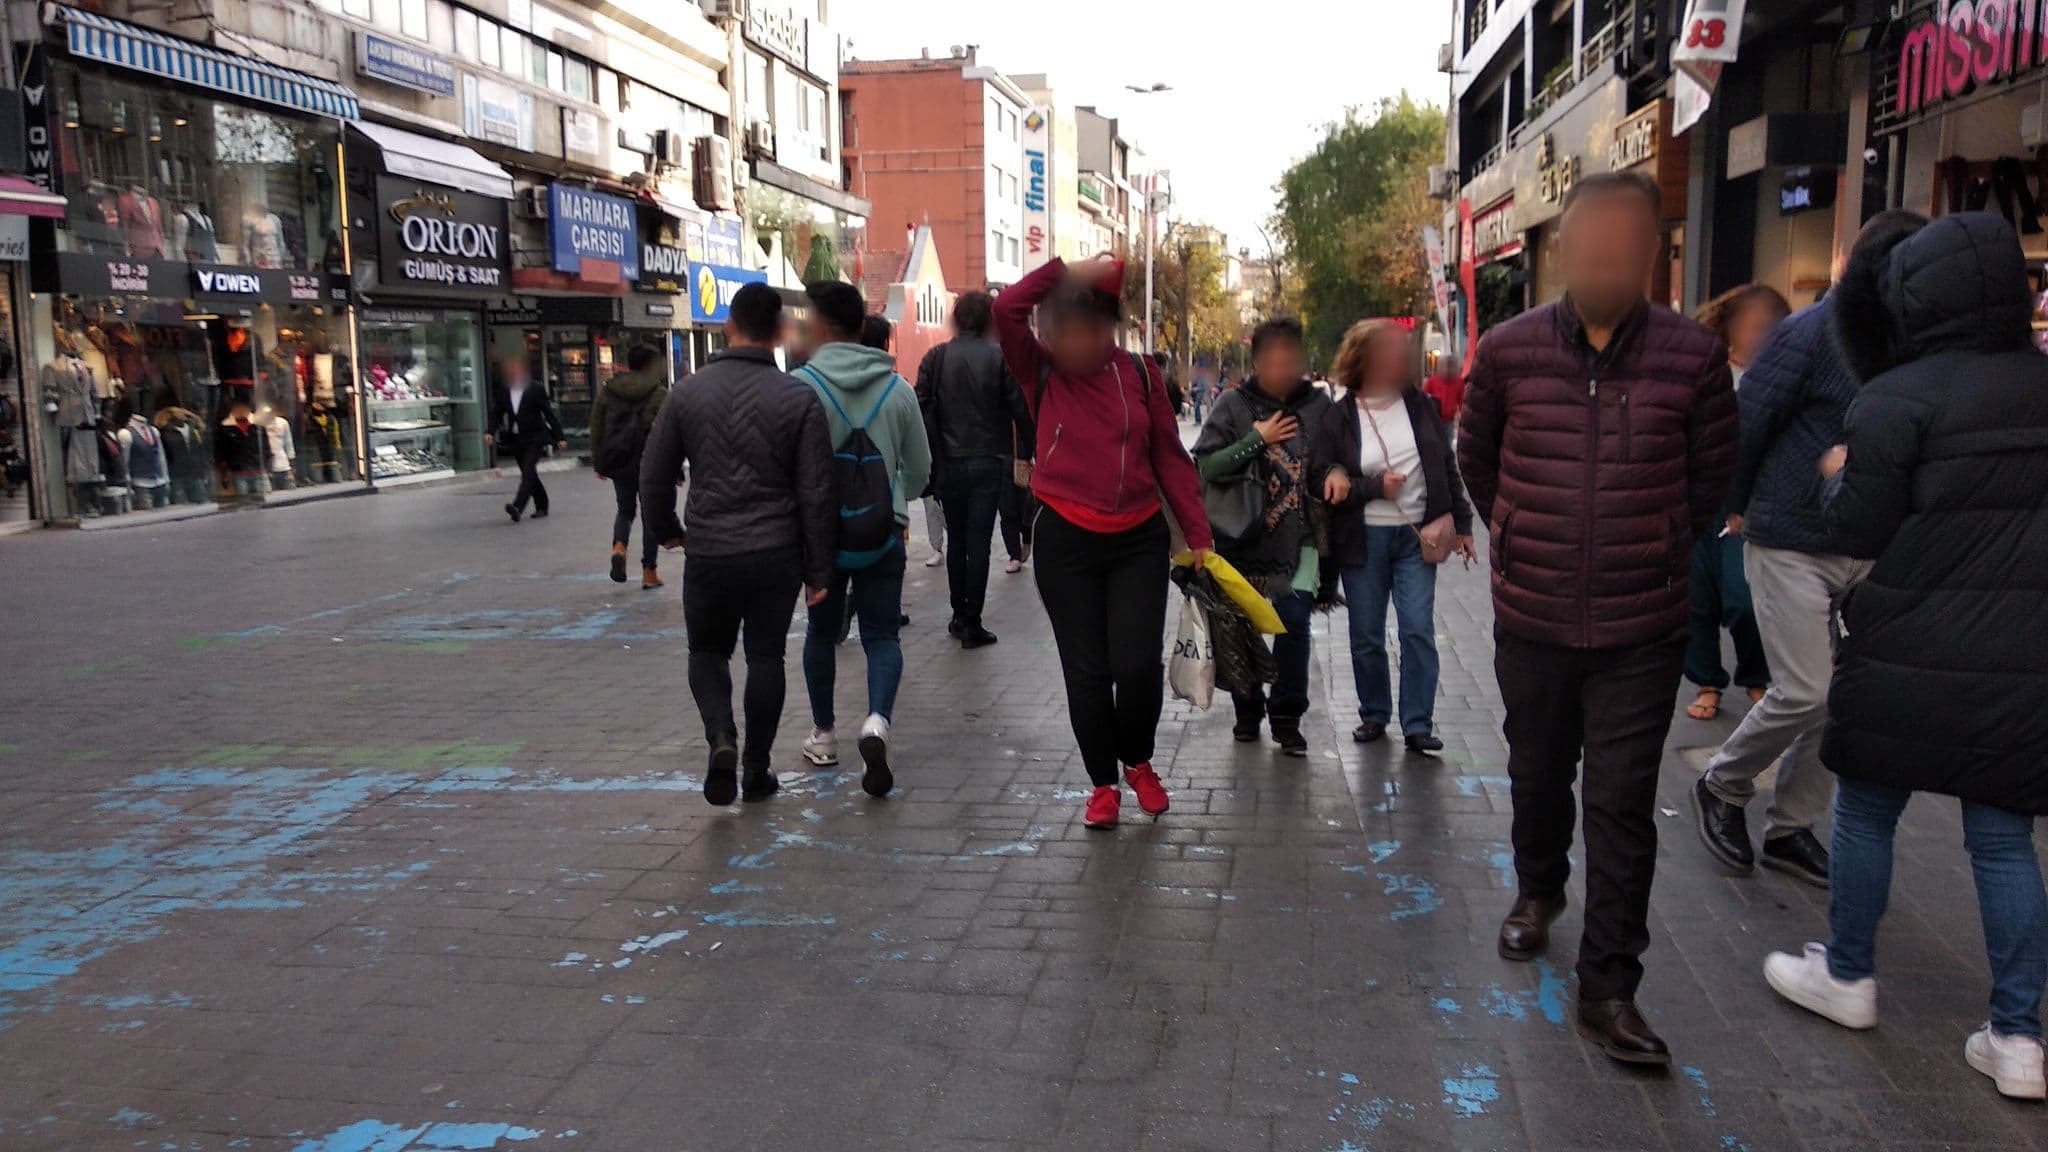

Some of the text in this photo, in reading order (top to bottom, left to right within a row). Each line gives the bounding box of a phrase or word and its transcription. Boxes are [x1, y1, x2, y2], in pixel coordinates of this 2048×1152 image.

[560, 190, 631, 231] MARMARA
[1025, 149, 1045, 254] vip final
[402, 214, 498, 260] ORION
[571, 223, 625, 259] ÇARŞISI
[404, 256, 501, 287] GÜMÜŞ & SAAT
[643, 244, 687, 275] DADYA
[215, 272, 261, 293] OWEN
